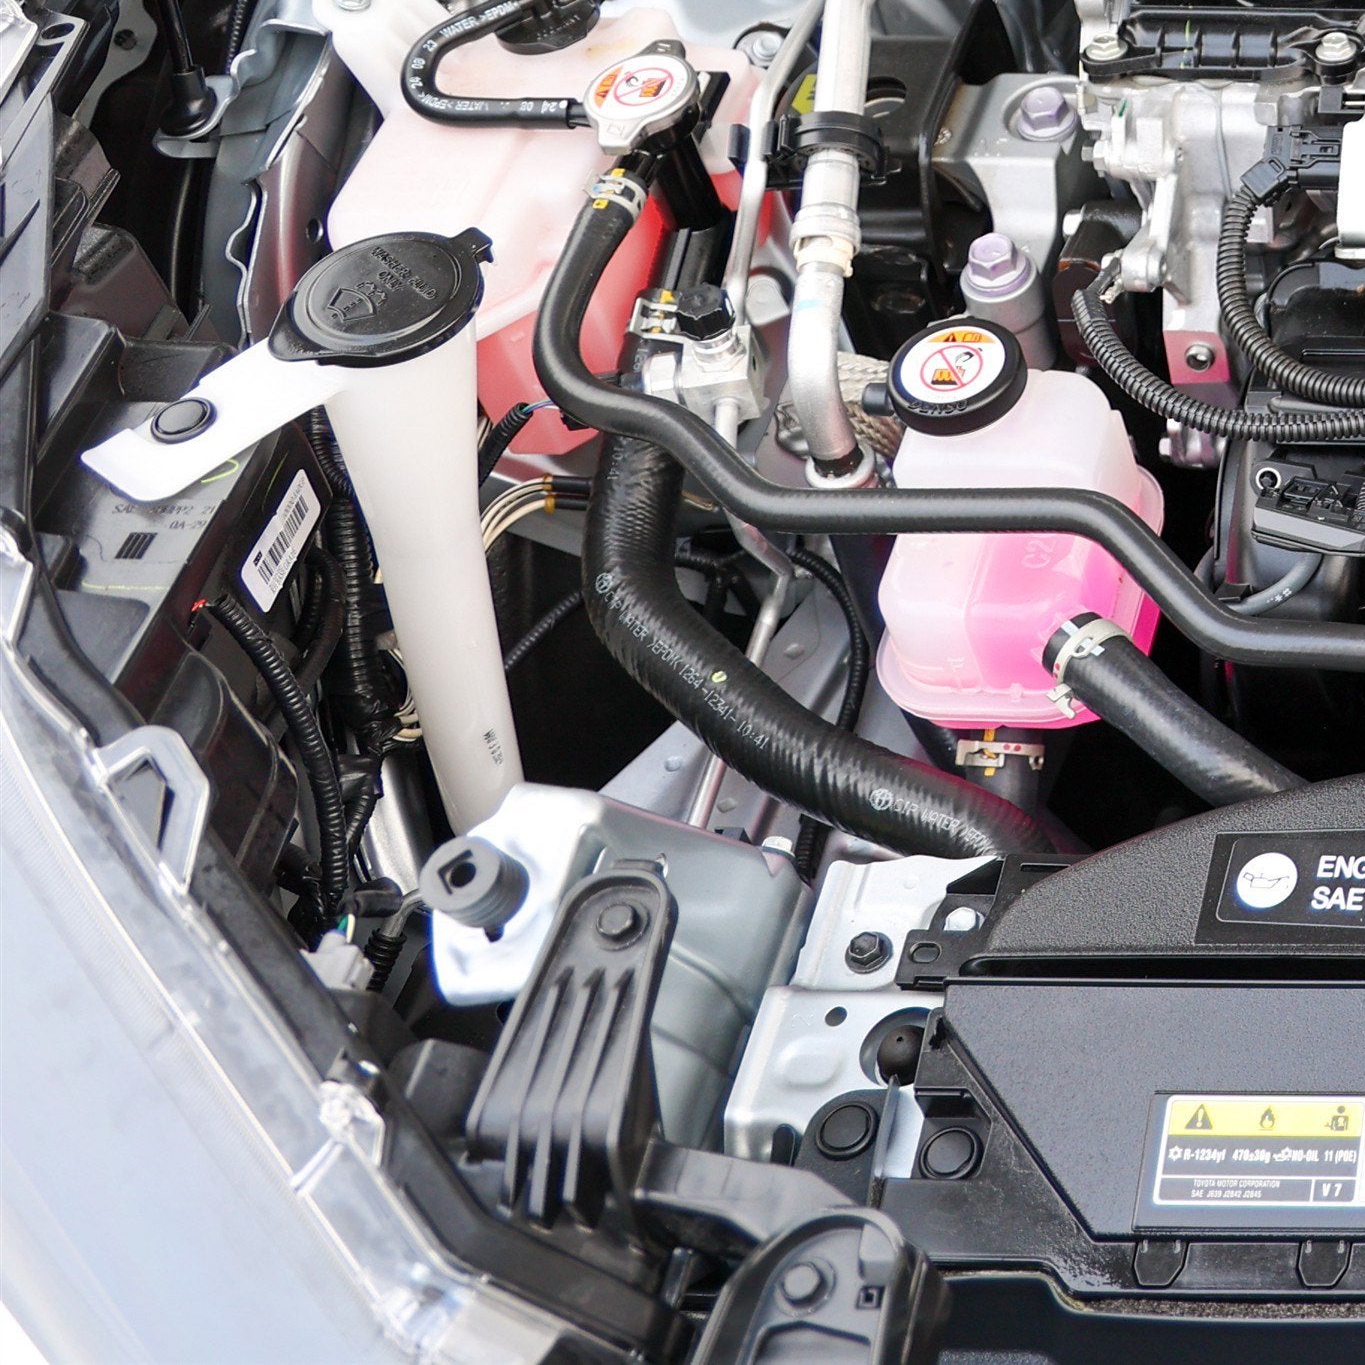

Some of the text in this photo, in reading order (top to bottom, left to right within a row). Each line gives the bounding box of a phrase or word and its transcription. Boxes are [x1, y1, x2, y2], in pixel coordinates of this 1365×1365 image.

[439, 16, 477, 38] WATER
[371, 246, 438, 300] WASHER FLUID
[619, 611, 649, 642] WATER
[921, 808, 960, 831] WATER
[1311, 885, 1365, 911] SAE
[1183, 1148, 1227, 1164] R-1234yf
[1324, 1149, 1334, 1162] 11
[1334, 1149, 1357, 1164] (POE)
[1191, 1189, 1204, 1198] SAE
[1193, 1179, 1281, 1189] TOYOTA MOTOR CORPORATION
[1322, 1183, 1342, 1197] V 7
